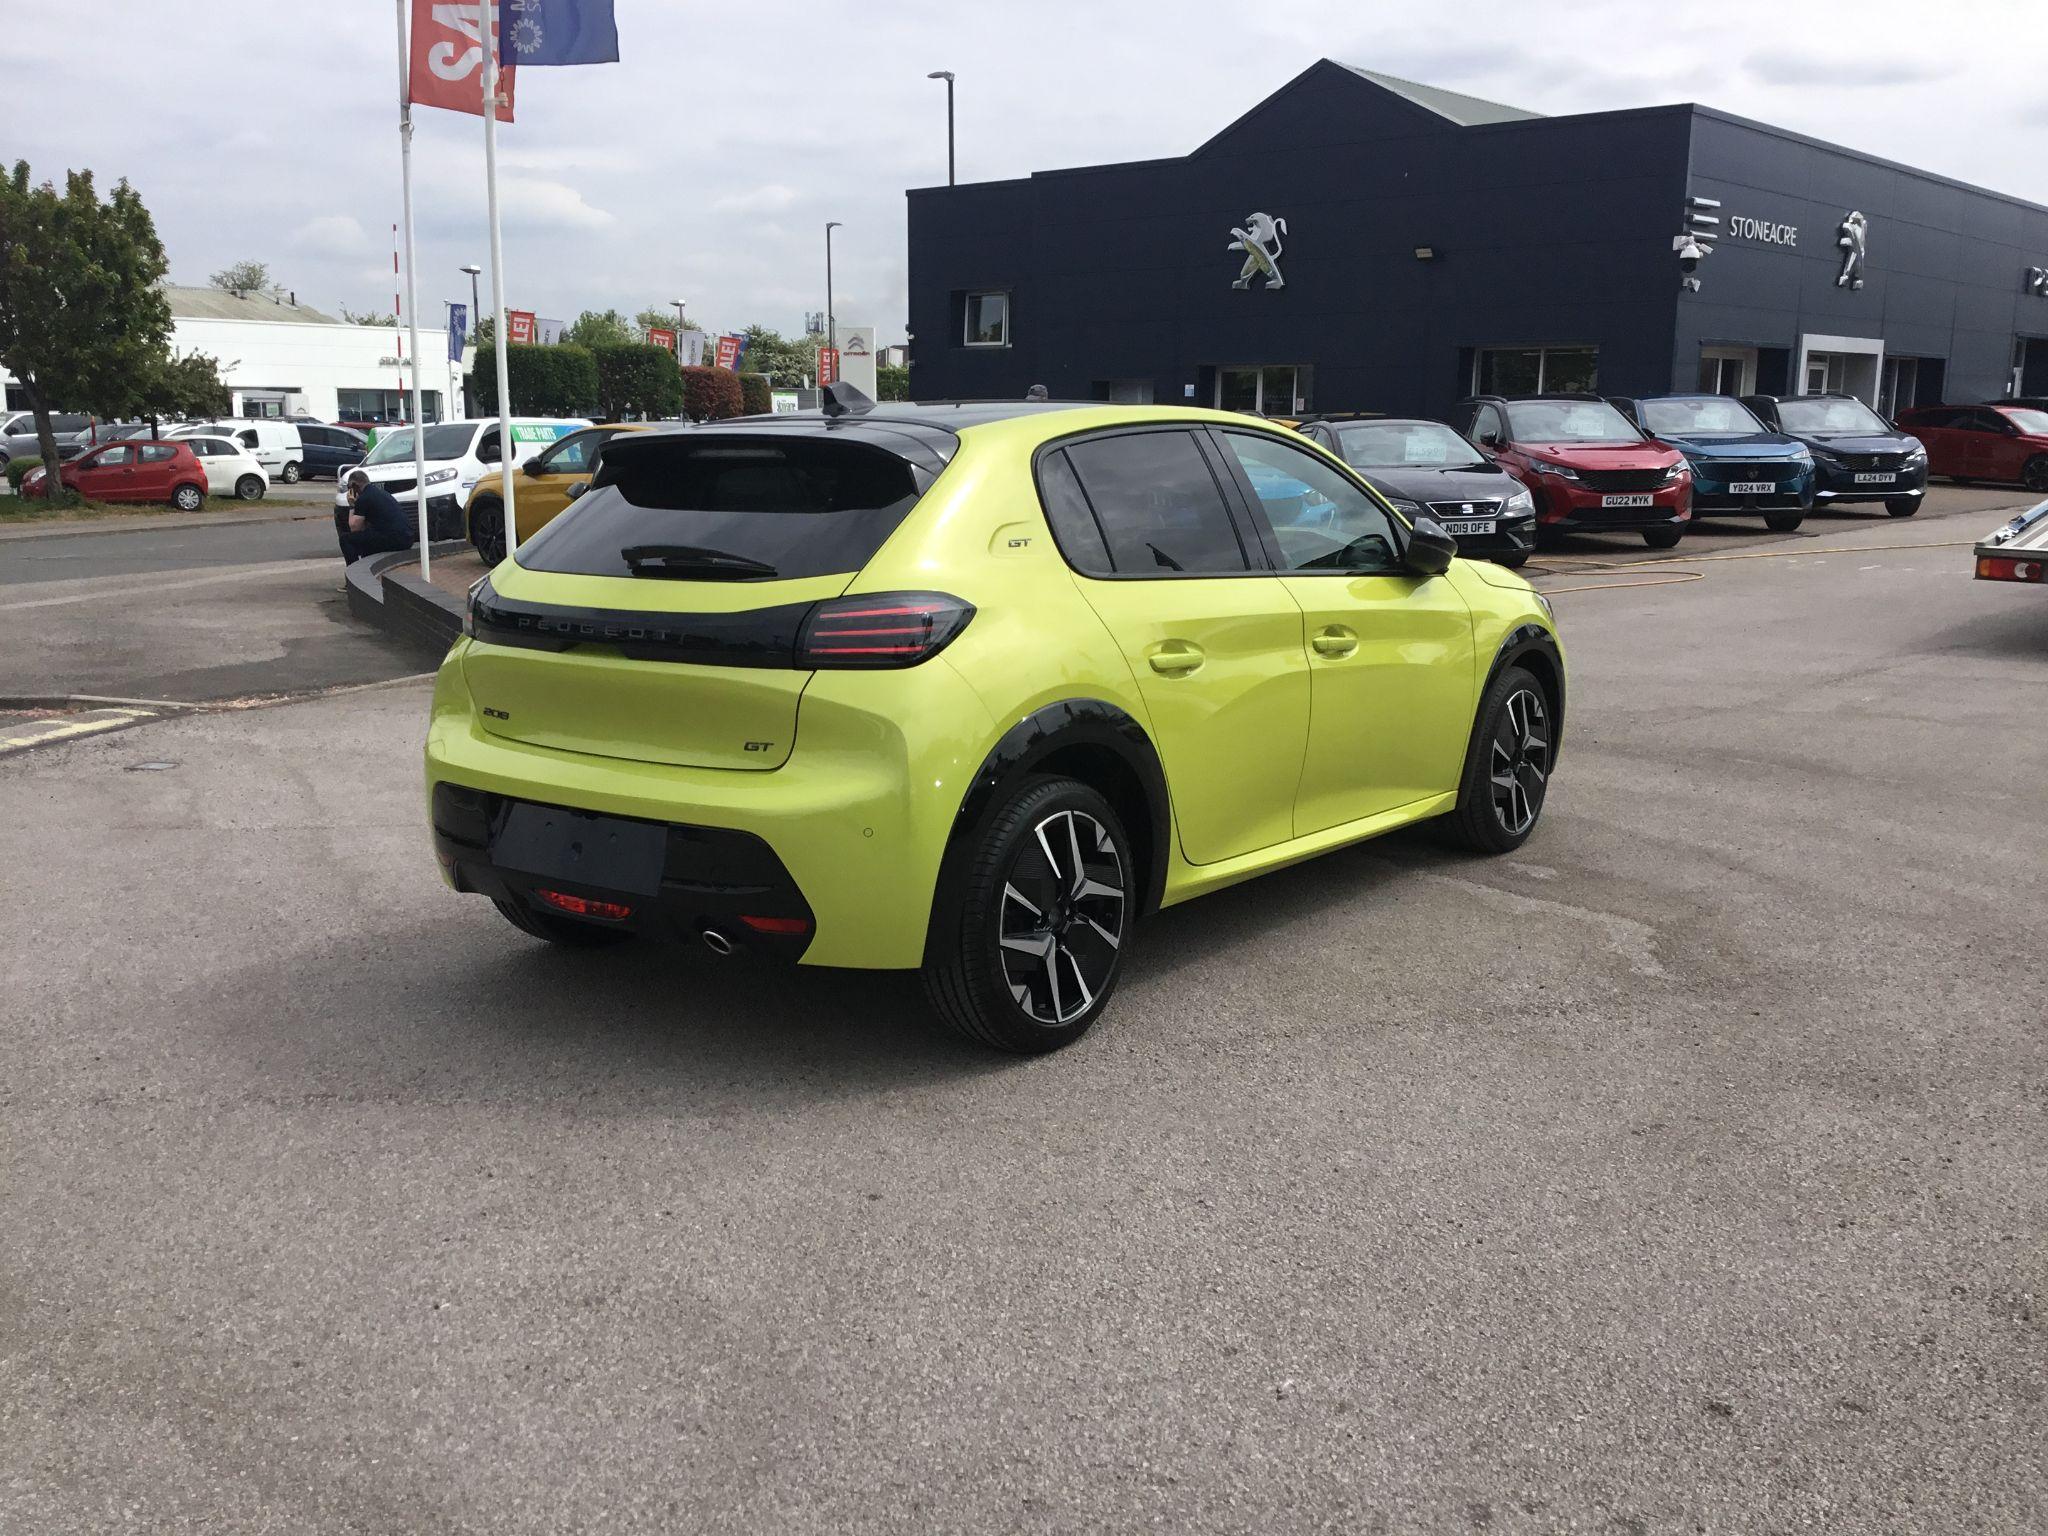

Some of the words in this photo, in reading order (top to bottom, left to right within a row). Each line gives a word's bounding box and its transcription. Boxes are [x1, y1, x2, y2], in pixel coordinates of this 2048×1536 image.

[1729, 215, 1798, 247] STONEACRE
[516, 426, 539, 441] TRADE
[536, 427, 557, 441] PARTS
[1756, 483, 1772, 492] VRX
[1605, 496, 1630, 506] GU22
[1631, 495, 1650, 505] MYK
[1445, 523, 1469, 534] ND19
[1470, 522, 1490, 533] OFE
[1008, 538, 1032, 548] GT
[518, 617, 672, 640] PEUGEOT
[483, 707, 510, 721] 208
[743, 742, 775, 752] GT
